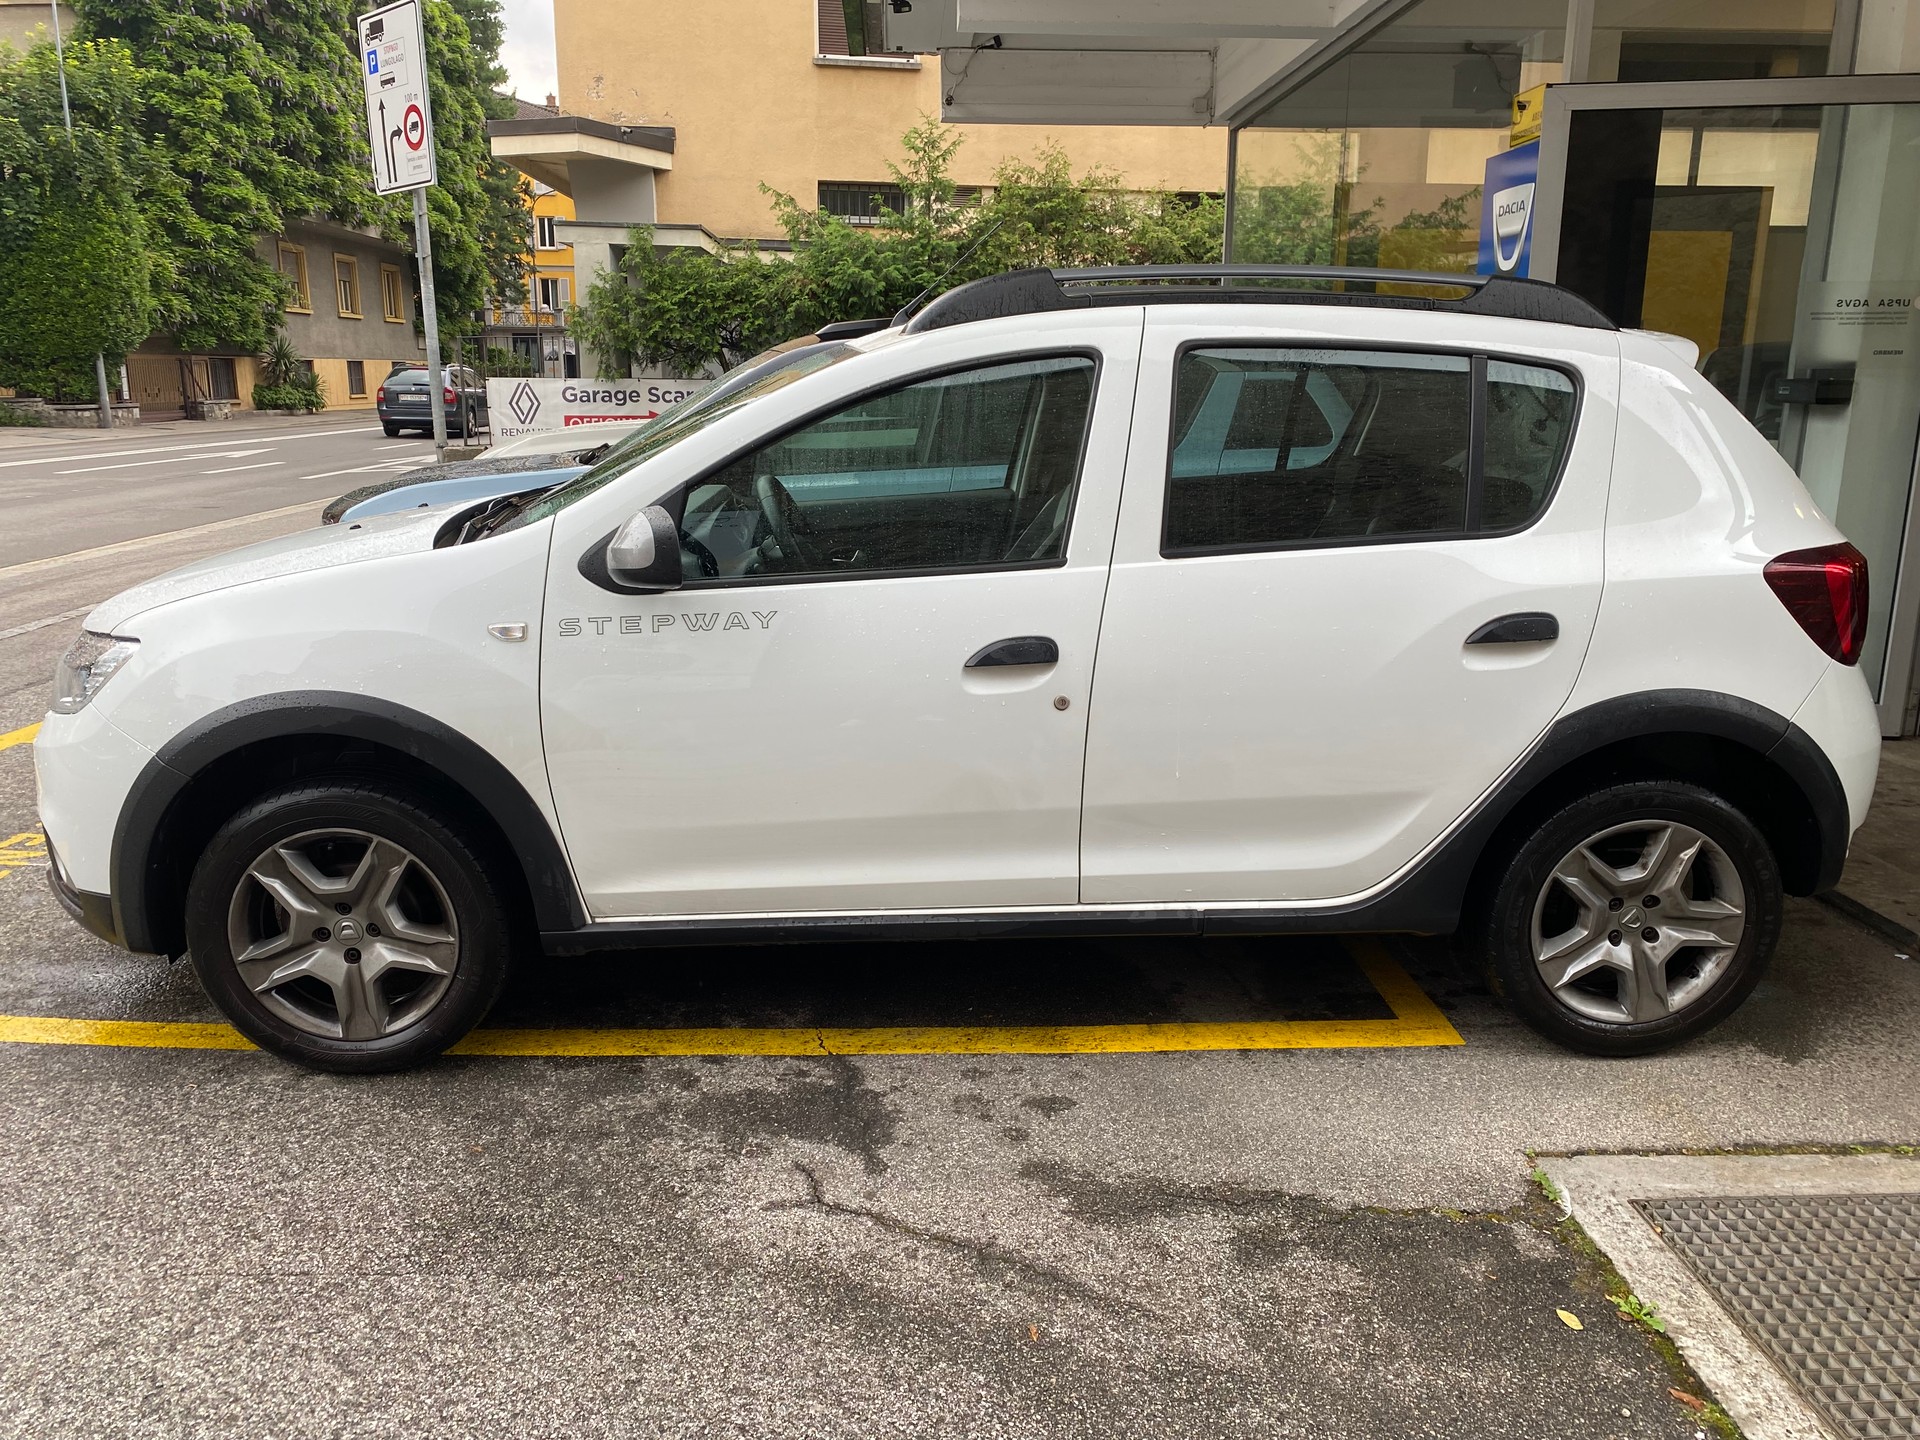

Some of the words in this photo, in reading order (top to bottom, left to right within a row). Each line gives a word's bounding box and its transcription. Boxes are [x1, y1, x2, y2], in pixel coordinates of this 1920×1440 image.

[370, 55, 376, 71] P
[1498, 200, 1526, 218] DACIA
[562, 386, 640, 406] Garage
[501, 427, 553, 437] RENA
[558, 610, 778, 637] STEPWAY
